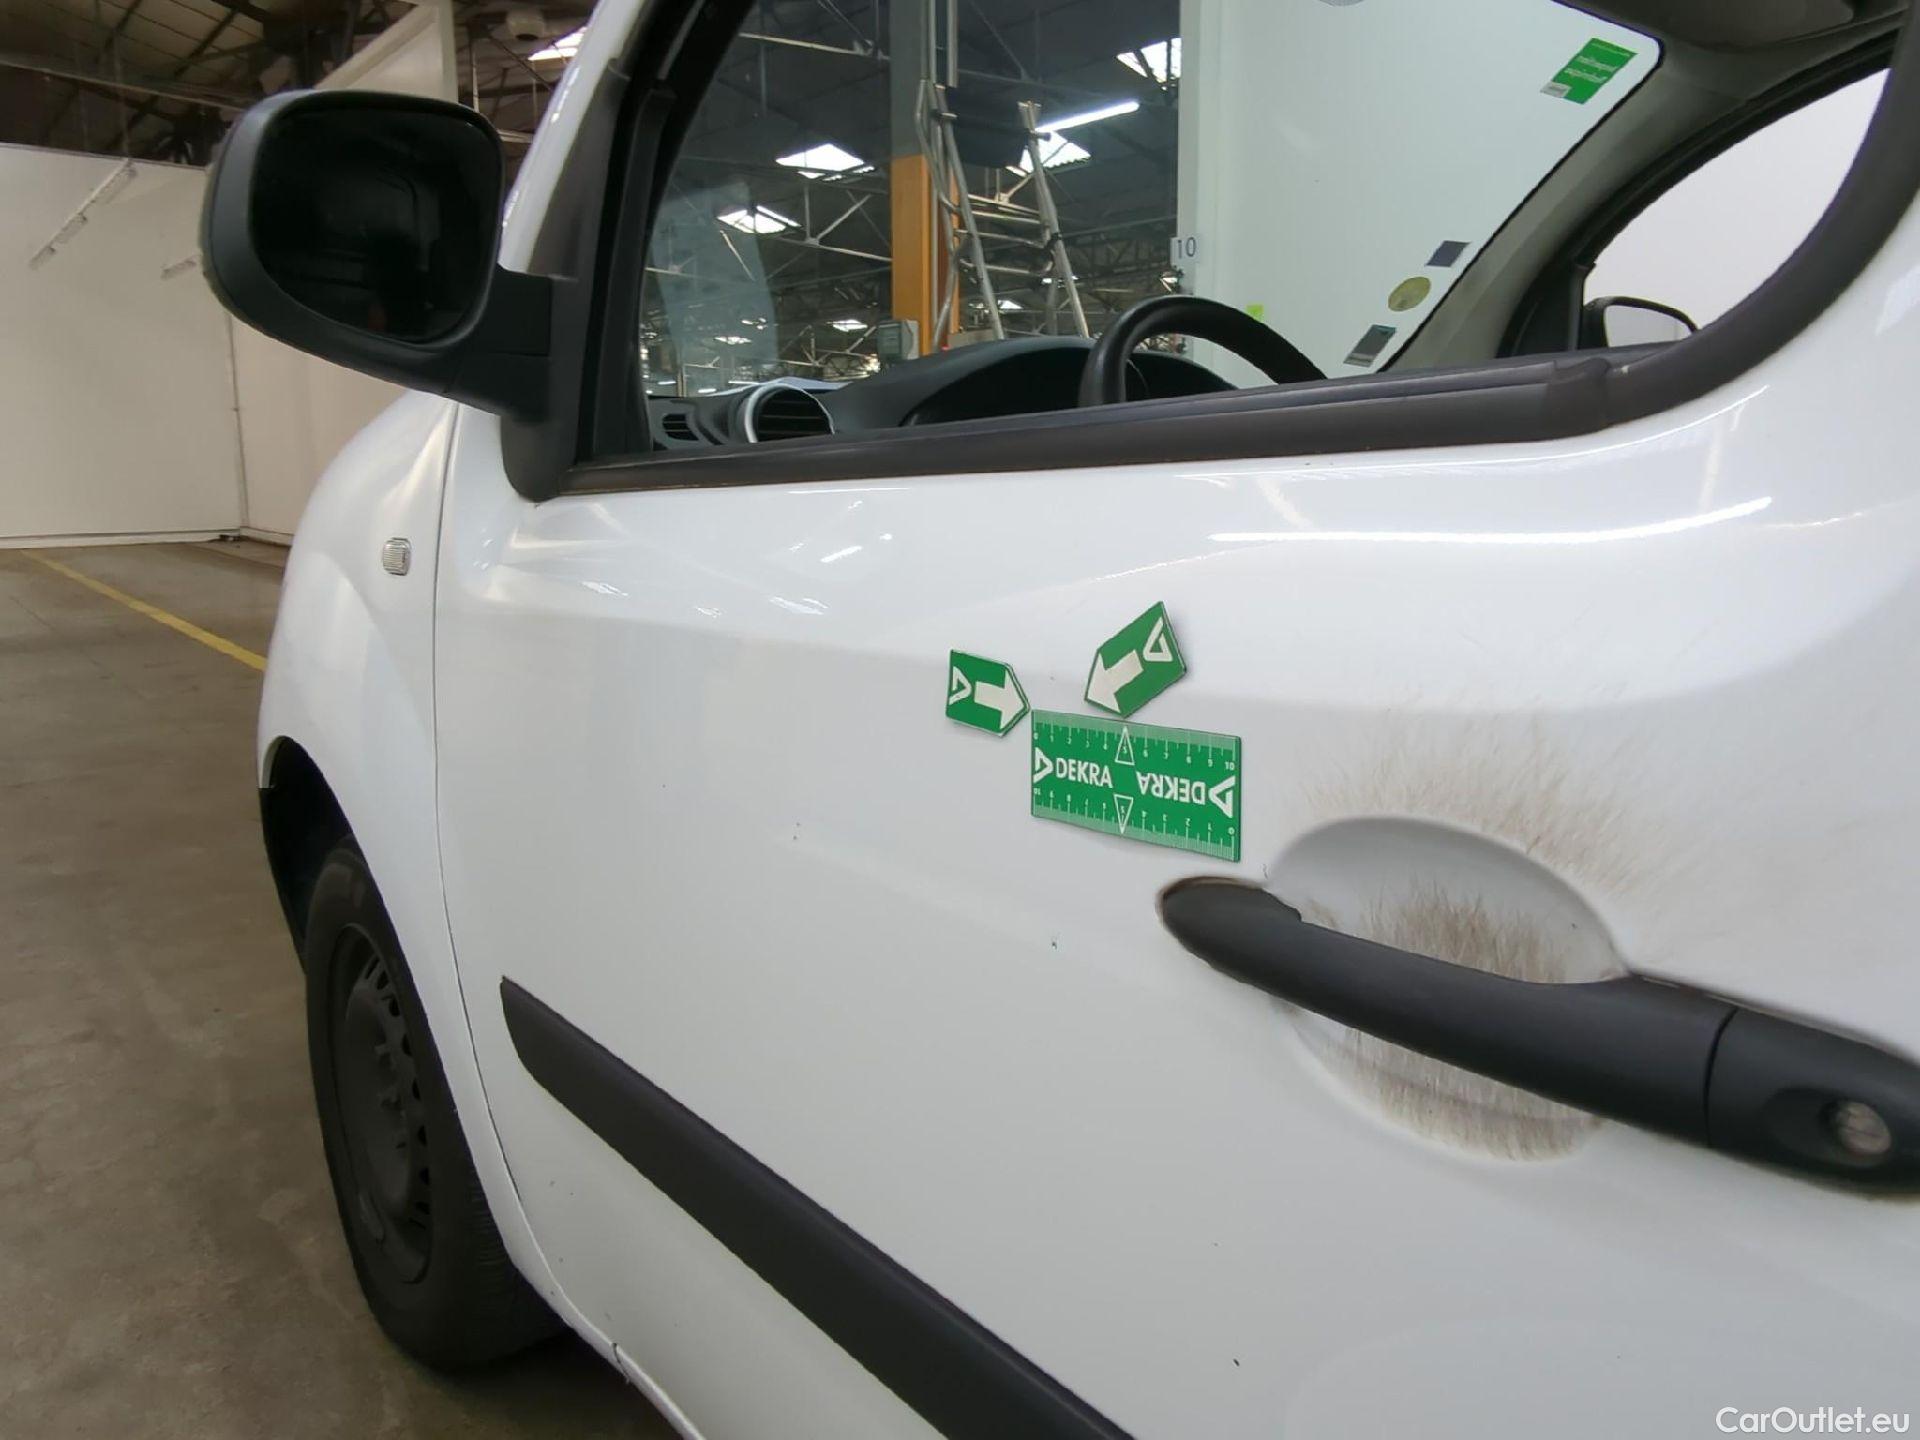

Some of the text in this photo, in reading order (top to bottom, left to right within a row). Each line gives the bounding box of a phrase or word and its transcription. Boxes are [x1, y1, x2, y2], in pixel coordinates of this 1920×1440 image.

[1178, 237, 1196, 259] 10
[1056, 757, 1113, 788] DEKRA
[1136, 771, 1206, 805] DEKRA
